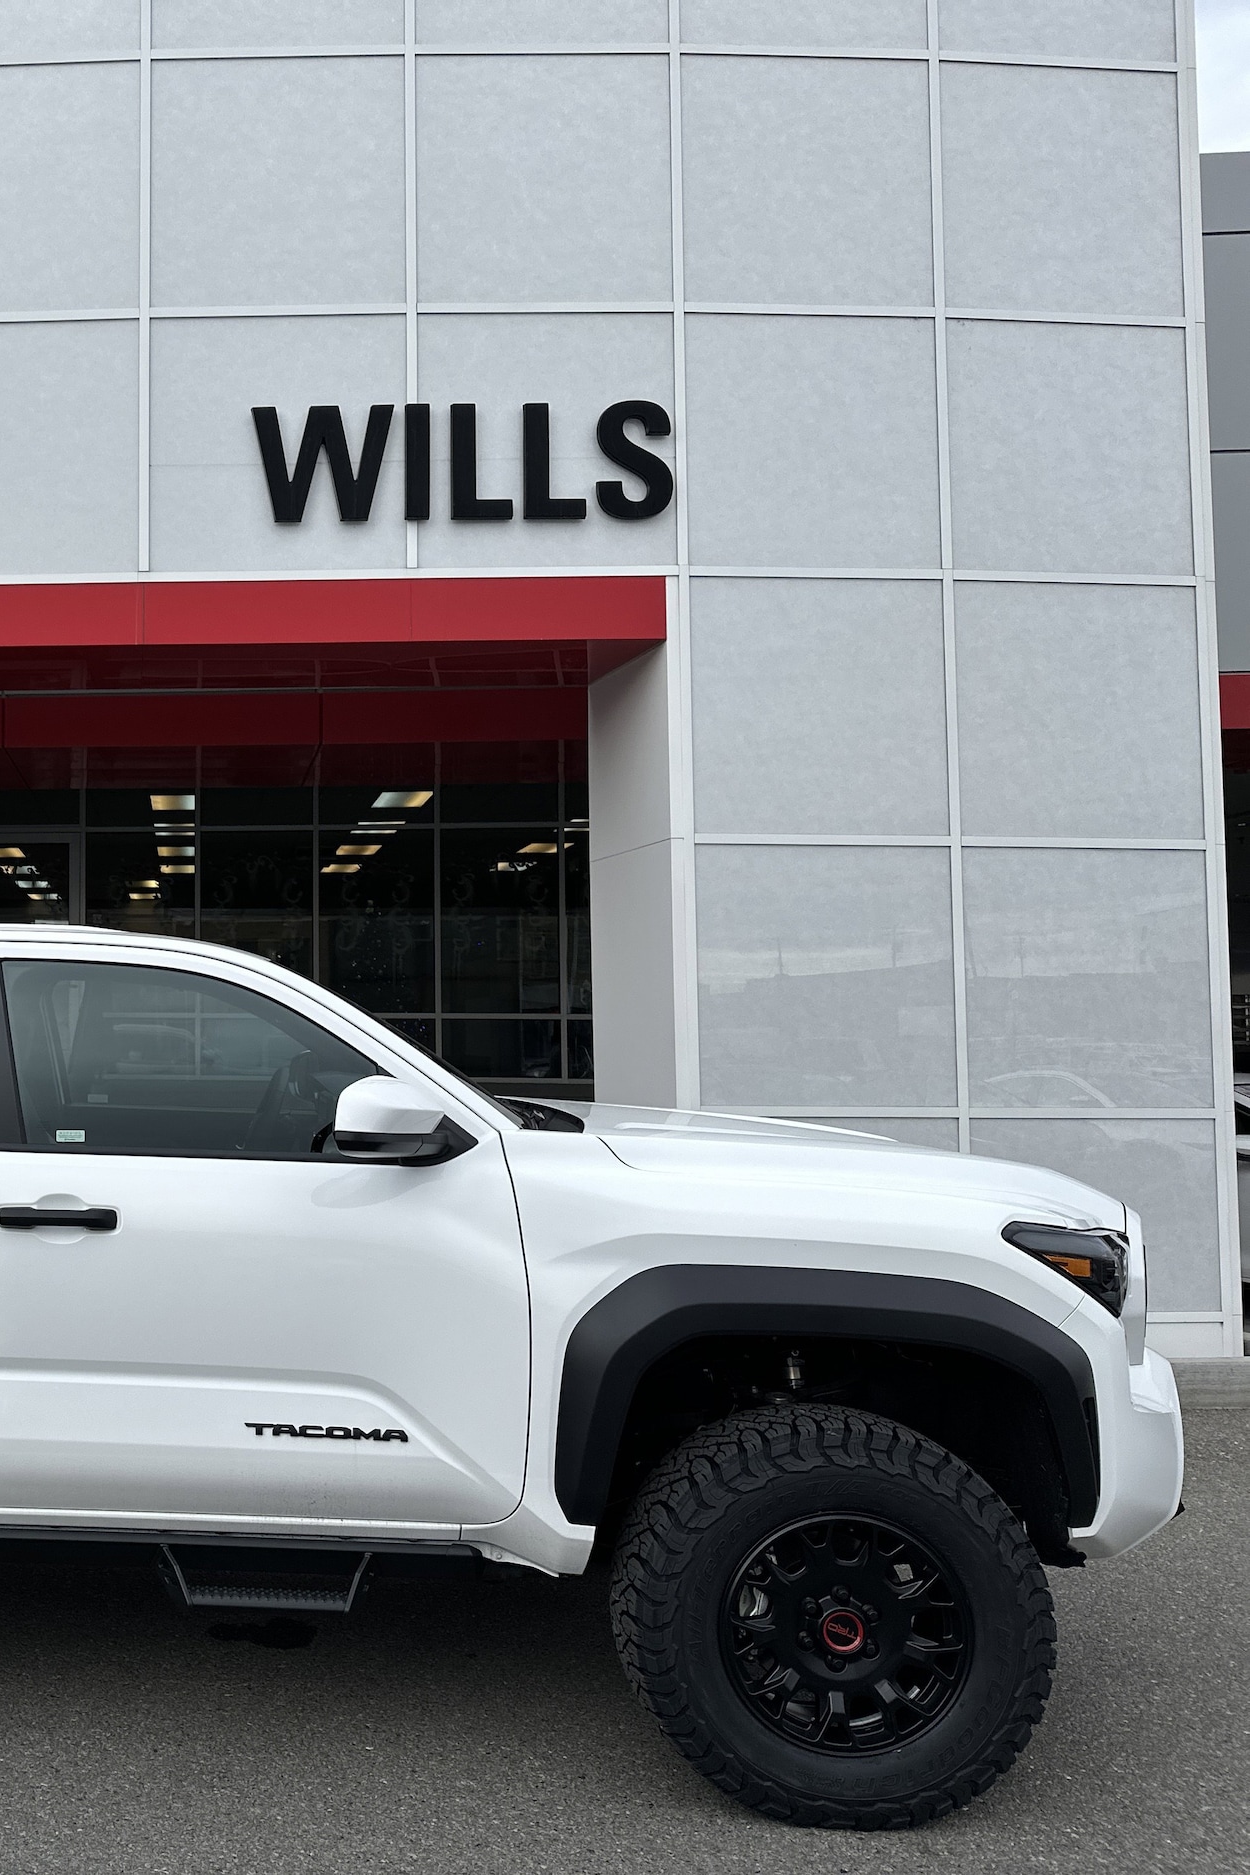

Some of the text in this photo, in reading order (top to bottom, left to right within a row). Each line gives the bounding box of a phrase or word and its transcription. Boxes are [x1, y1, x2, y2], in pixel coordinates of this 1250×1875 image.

[251, 400, 674, 522] WILLS
[245, 1422, 408, 1442] TACOMA
[828, 1623, 856, 1640] TRD
